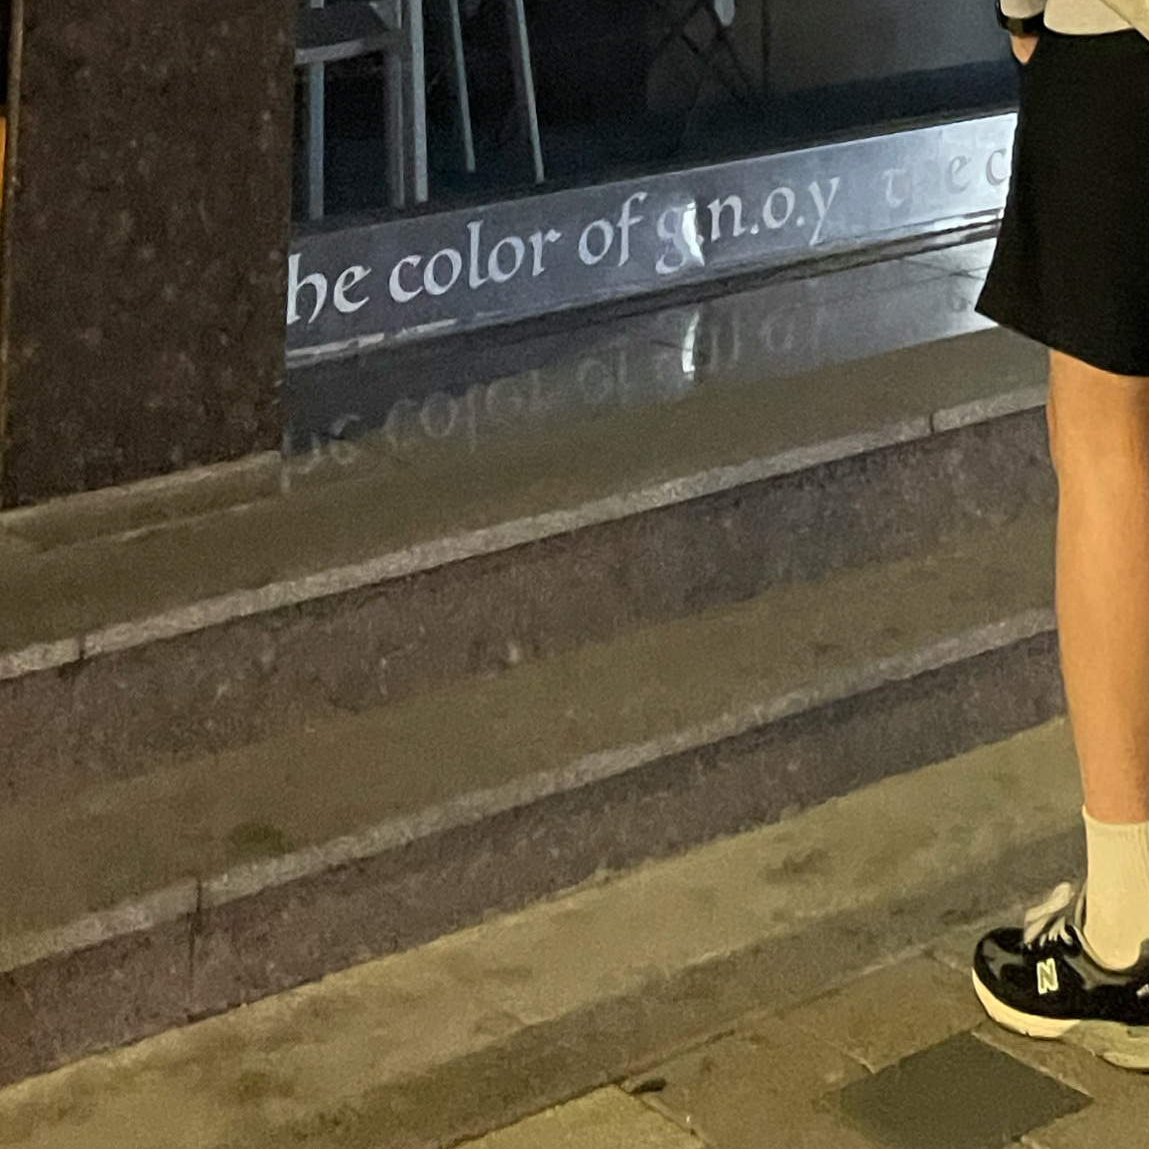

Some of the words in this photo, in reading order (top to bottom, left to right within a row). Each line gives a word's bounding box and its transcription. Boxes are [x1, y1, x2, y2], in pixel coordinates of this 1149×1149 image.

[286, 253, 372, 323] he
[388, 219, 562, 303] color
[578, 191, 647, 267] of
[1036, 957, 1059, 995] N
